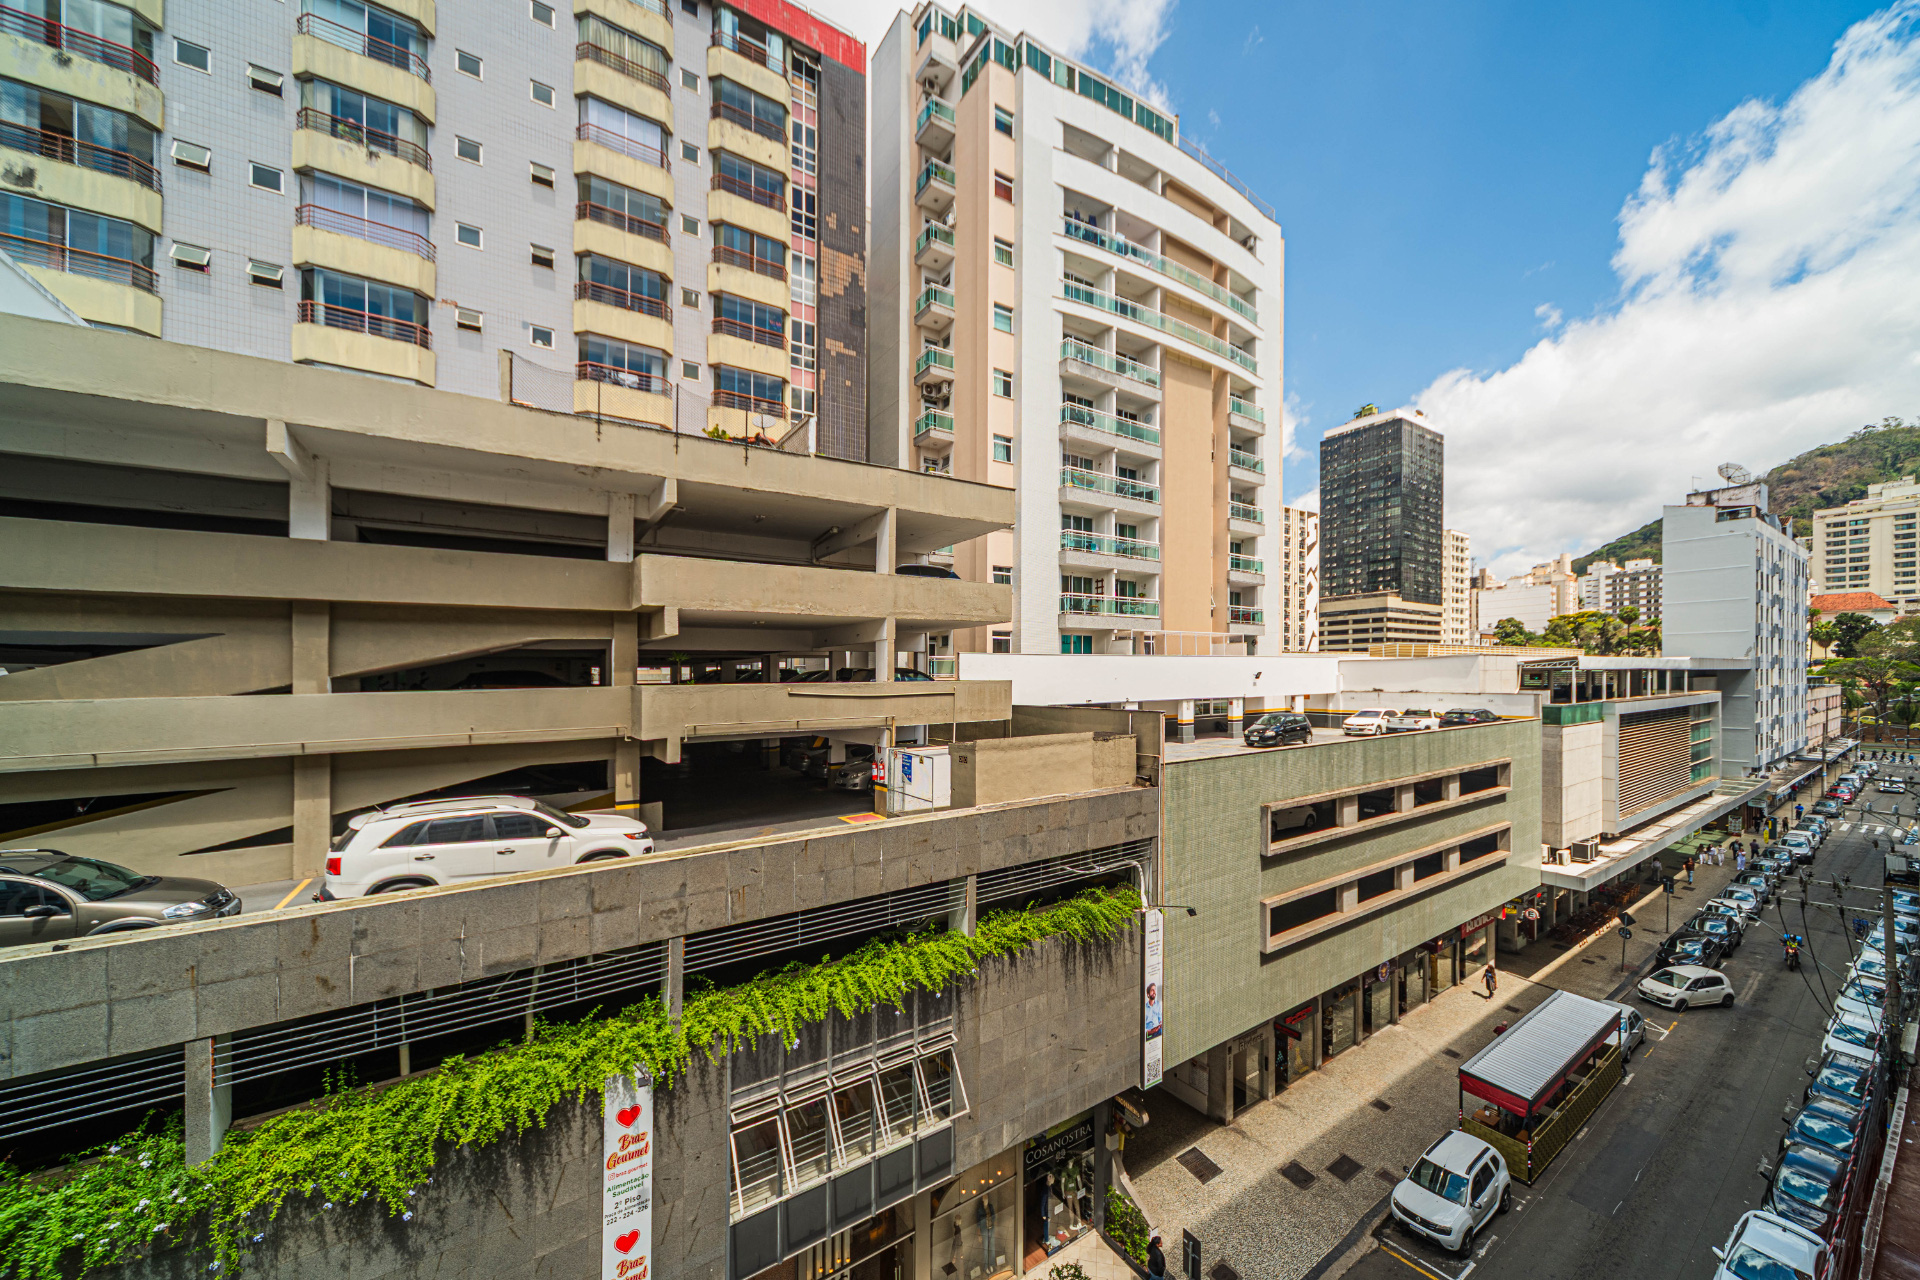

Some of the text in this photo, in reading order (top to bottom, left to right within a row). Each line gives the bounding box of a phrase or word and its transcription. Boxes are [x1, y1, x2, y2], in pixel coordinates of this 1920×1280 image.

[617, 1131, 648, 1152] Braz
[1025, 1123, 1092, 1164] COSANOSTRA
[606, 1141, 650, 1171] Gourmet
[606, 1173, 650, 1193] Alimentação
[612, 1181, 644, 1198] Saudável
[624, 1194, 642, 1206] Piso
[606, 1215, 618, 1226] 222
[622, 1210, 634, 1220] 224
[615, 1255, 647, 1278] Braz
